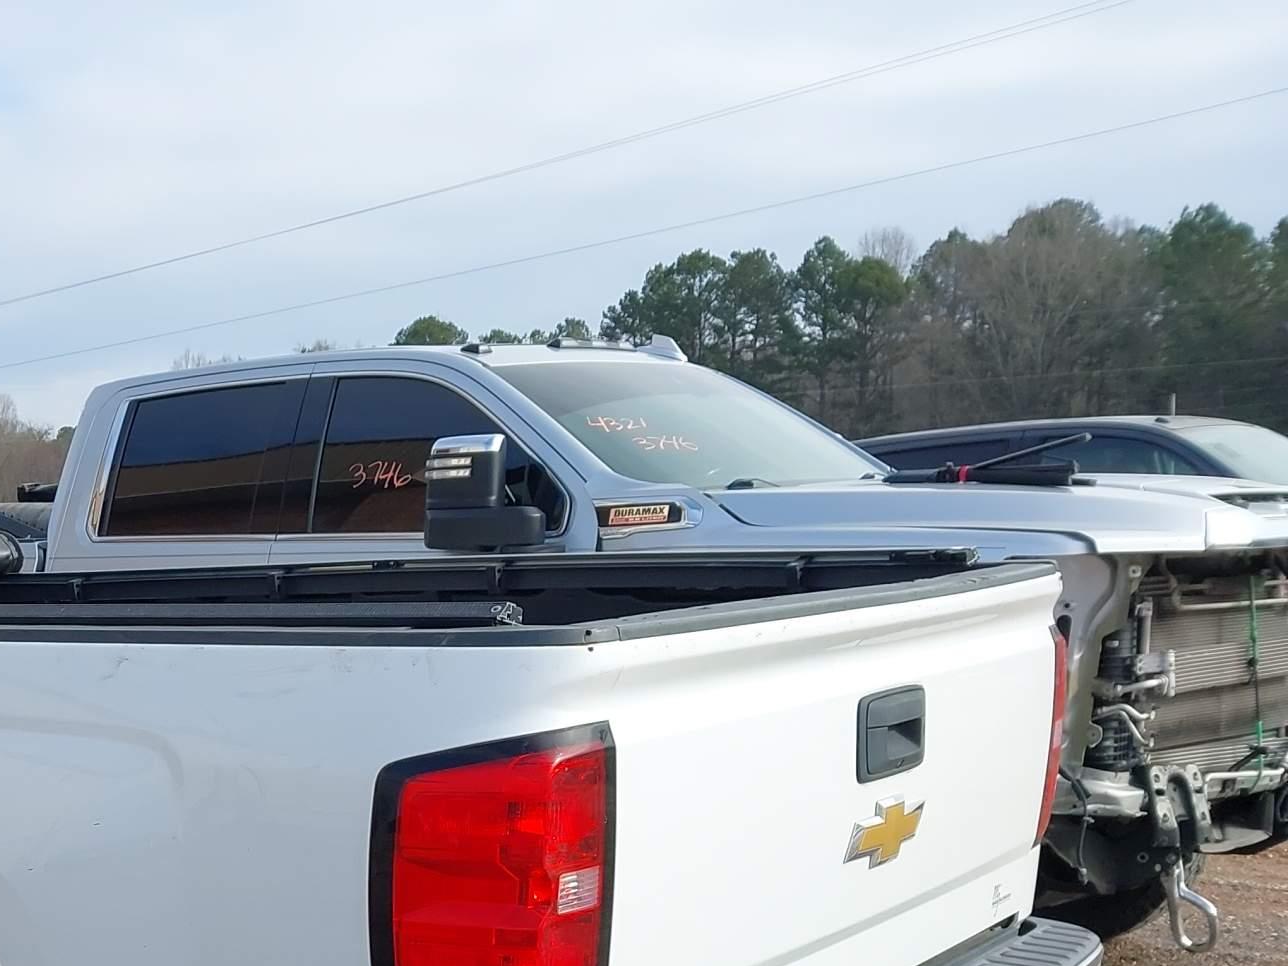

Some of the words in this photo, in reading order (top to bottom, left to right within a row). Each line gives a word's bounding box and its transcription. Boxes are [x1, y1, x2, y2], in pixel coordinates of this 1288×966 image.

[586, 416, 647, 433] 4321
[349, 460, 412, 489] 3746
[613, 506, 667, 517] DURAMAX
